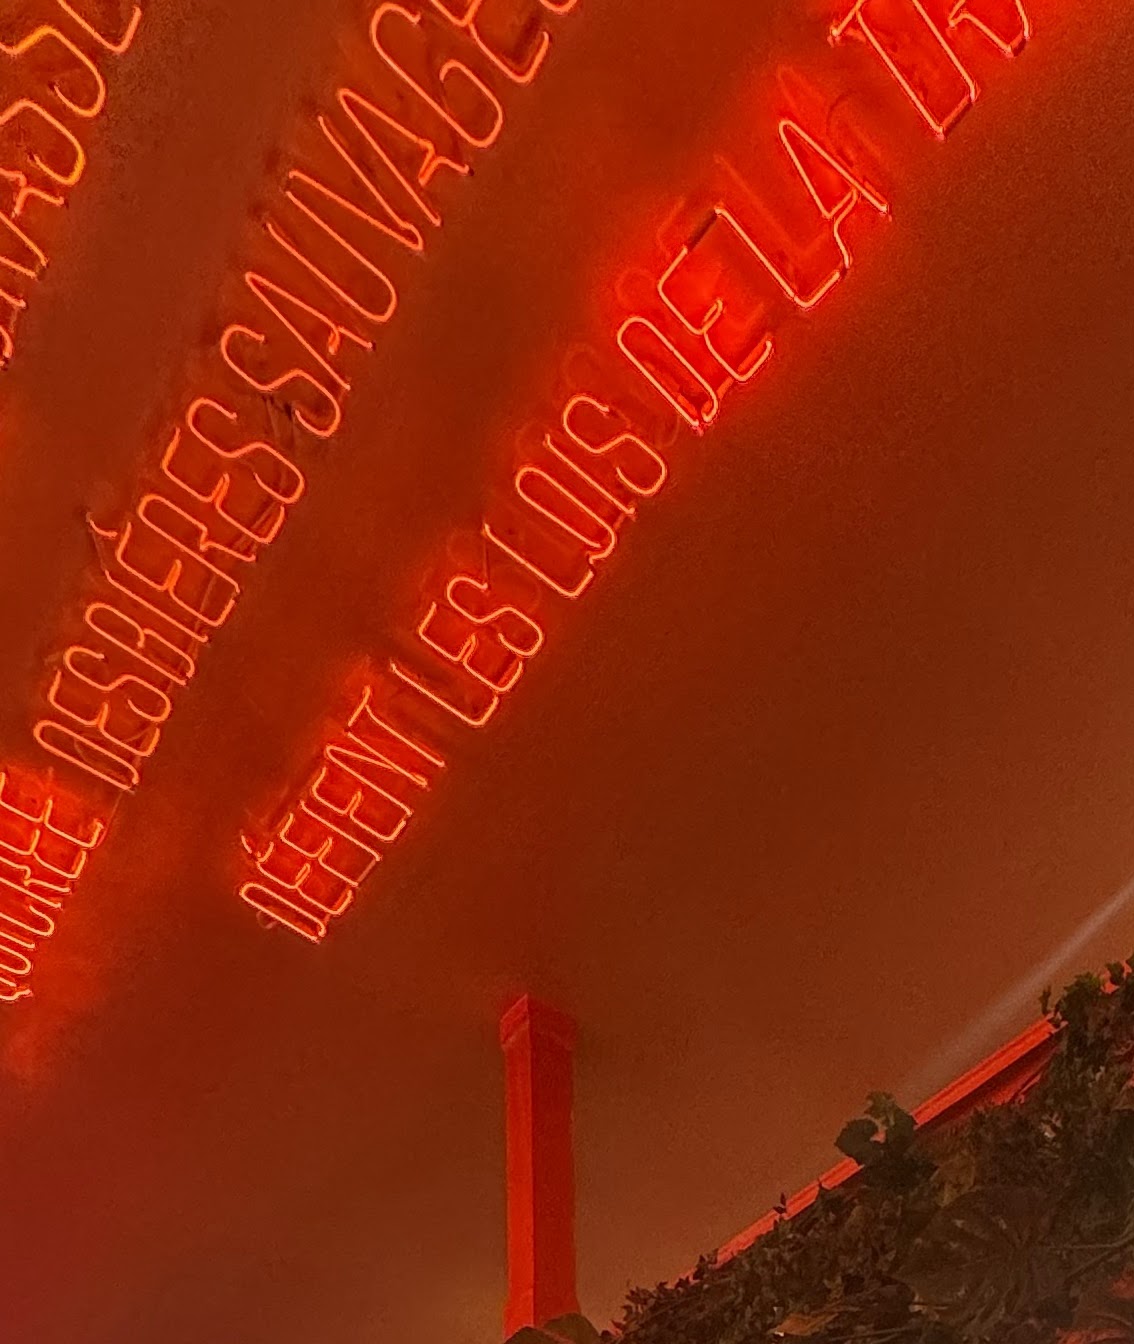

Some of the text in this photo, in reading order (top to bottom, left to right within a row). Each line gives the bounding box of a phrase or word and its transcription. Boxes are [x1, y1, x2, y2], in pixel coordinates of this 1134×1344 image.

[220, 0, 578, 438] SAUVAGE
[390, 574, 545, 728] LES
[484, 394, 667, 599] LOIS
